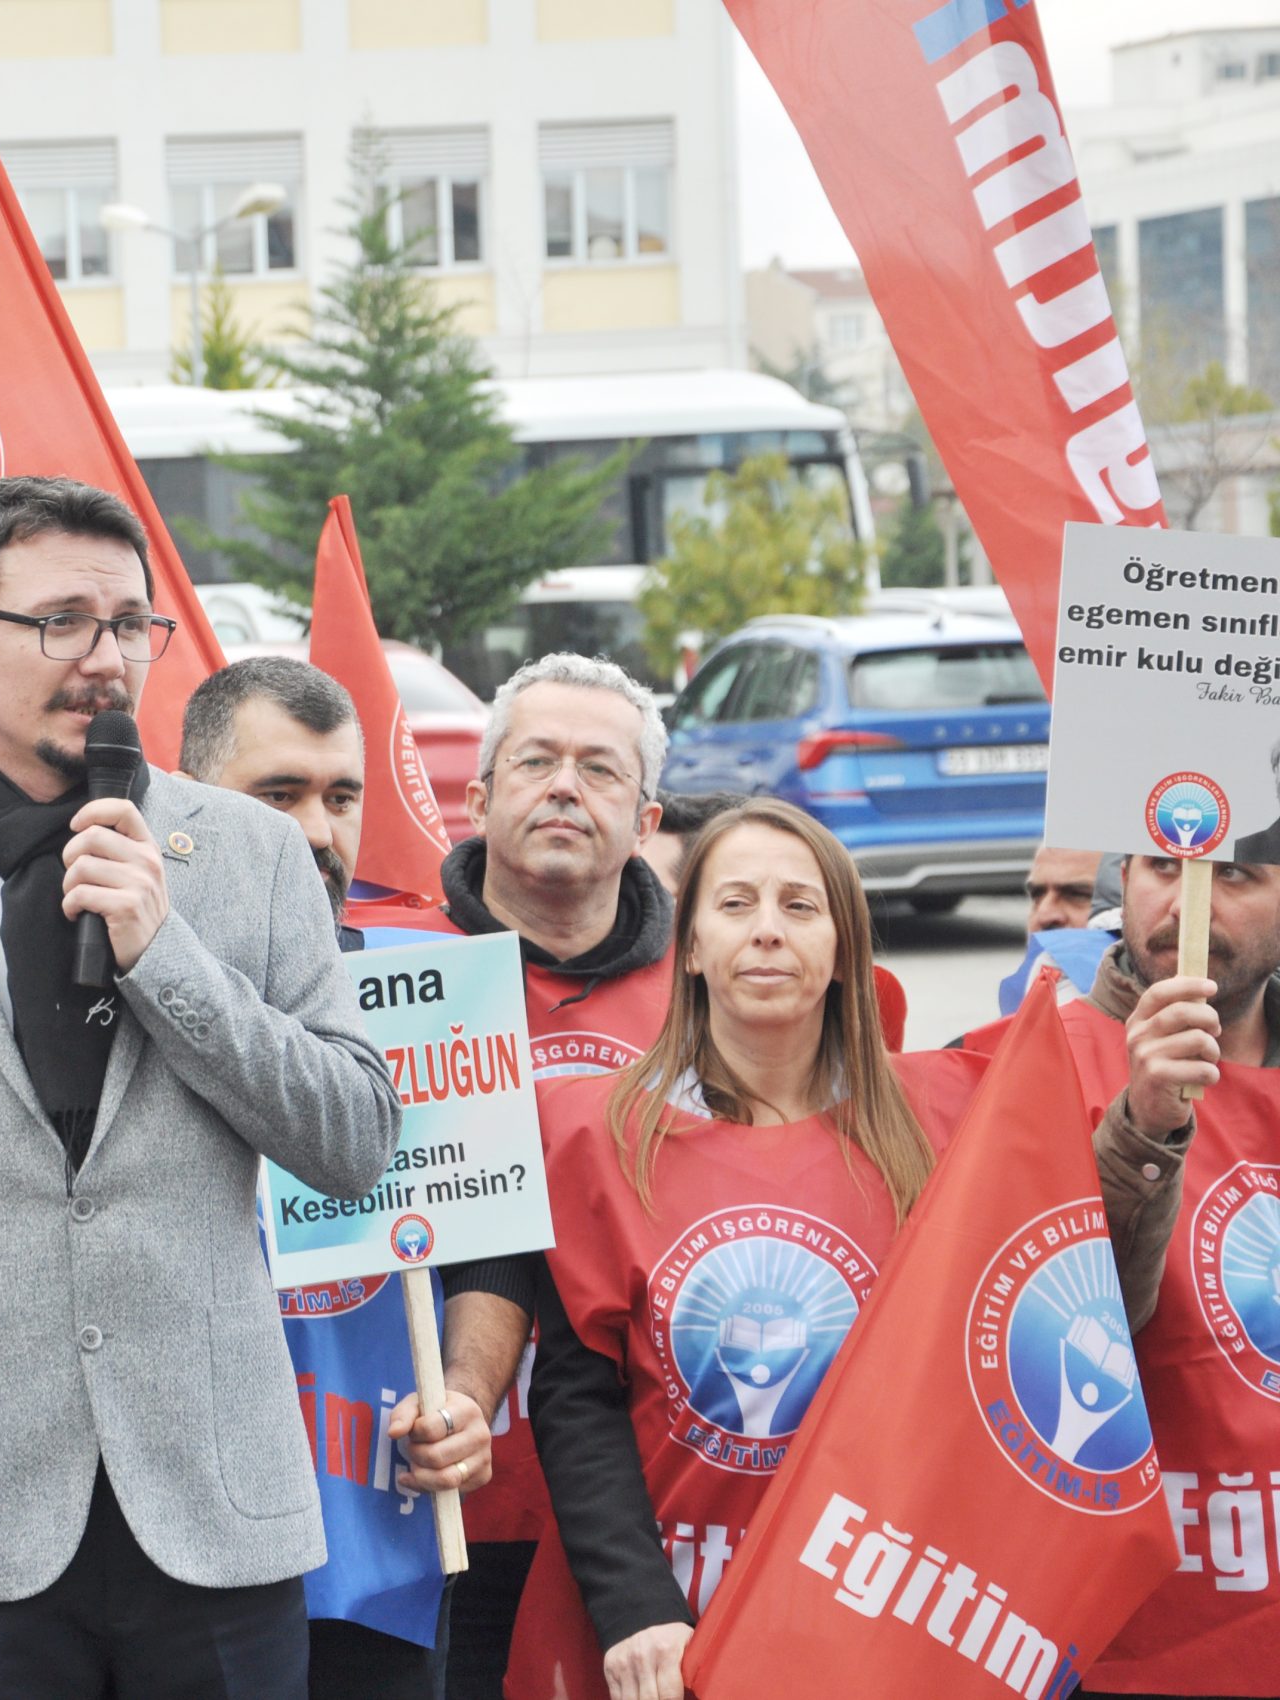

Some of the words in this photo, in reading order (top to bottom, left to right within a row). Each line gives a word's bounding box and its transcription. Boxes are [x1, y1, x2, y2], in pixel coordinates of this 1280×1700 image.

[1123, 556, 1278, 594] Öğretmen
[1067, 603, 1191, 630] egemen
[1201, 614, 1280, 637] sınıfl
[1058, 644, 1128, 667] emir
[1137, 647, 1203, 674] kulu
[1214, 654, 1280, 685] deği
[1249, 686, 1280, 706] Ba
[358, 968, 446, 1011] ana
[385, 1024, 521, 1106] ZLUĞUN
[532, 1039, 637, 1067] ŞGÖREN
[384, 1142, 466, 1173] asını
[280, 1183, 417, 1226] Kesebilir
[426, 1164, 527, 1204] misin?
[1203, 1185, 1243, 1236] BİLİM
[661, 1232, 709, 1290] BİLİM
[710, 1212, 870, 1283] İŞGÖRENLERİ
[1200, 1239, 1216, 1265] VE
[278, 1277, 366, 1313] TİM-İŞ
[742, 1302, 784, 1315] 2005
[975, 1273, 1014, 1370] EĞİTİM
[1009, 1240, 1042, 1271] VE
[1042, 1209, 1106, 1247] BİLİM
[1201, 1272, 1246, 1354] EĞİTİM
[686, 1424, 787, 1467] EĞİTİM
[986, 1398, 1121, 1511] EĞİTİM-İŞ
